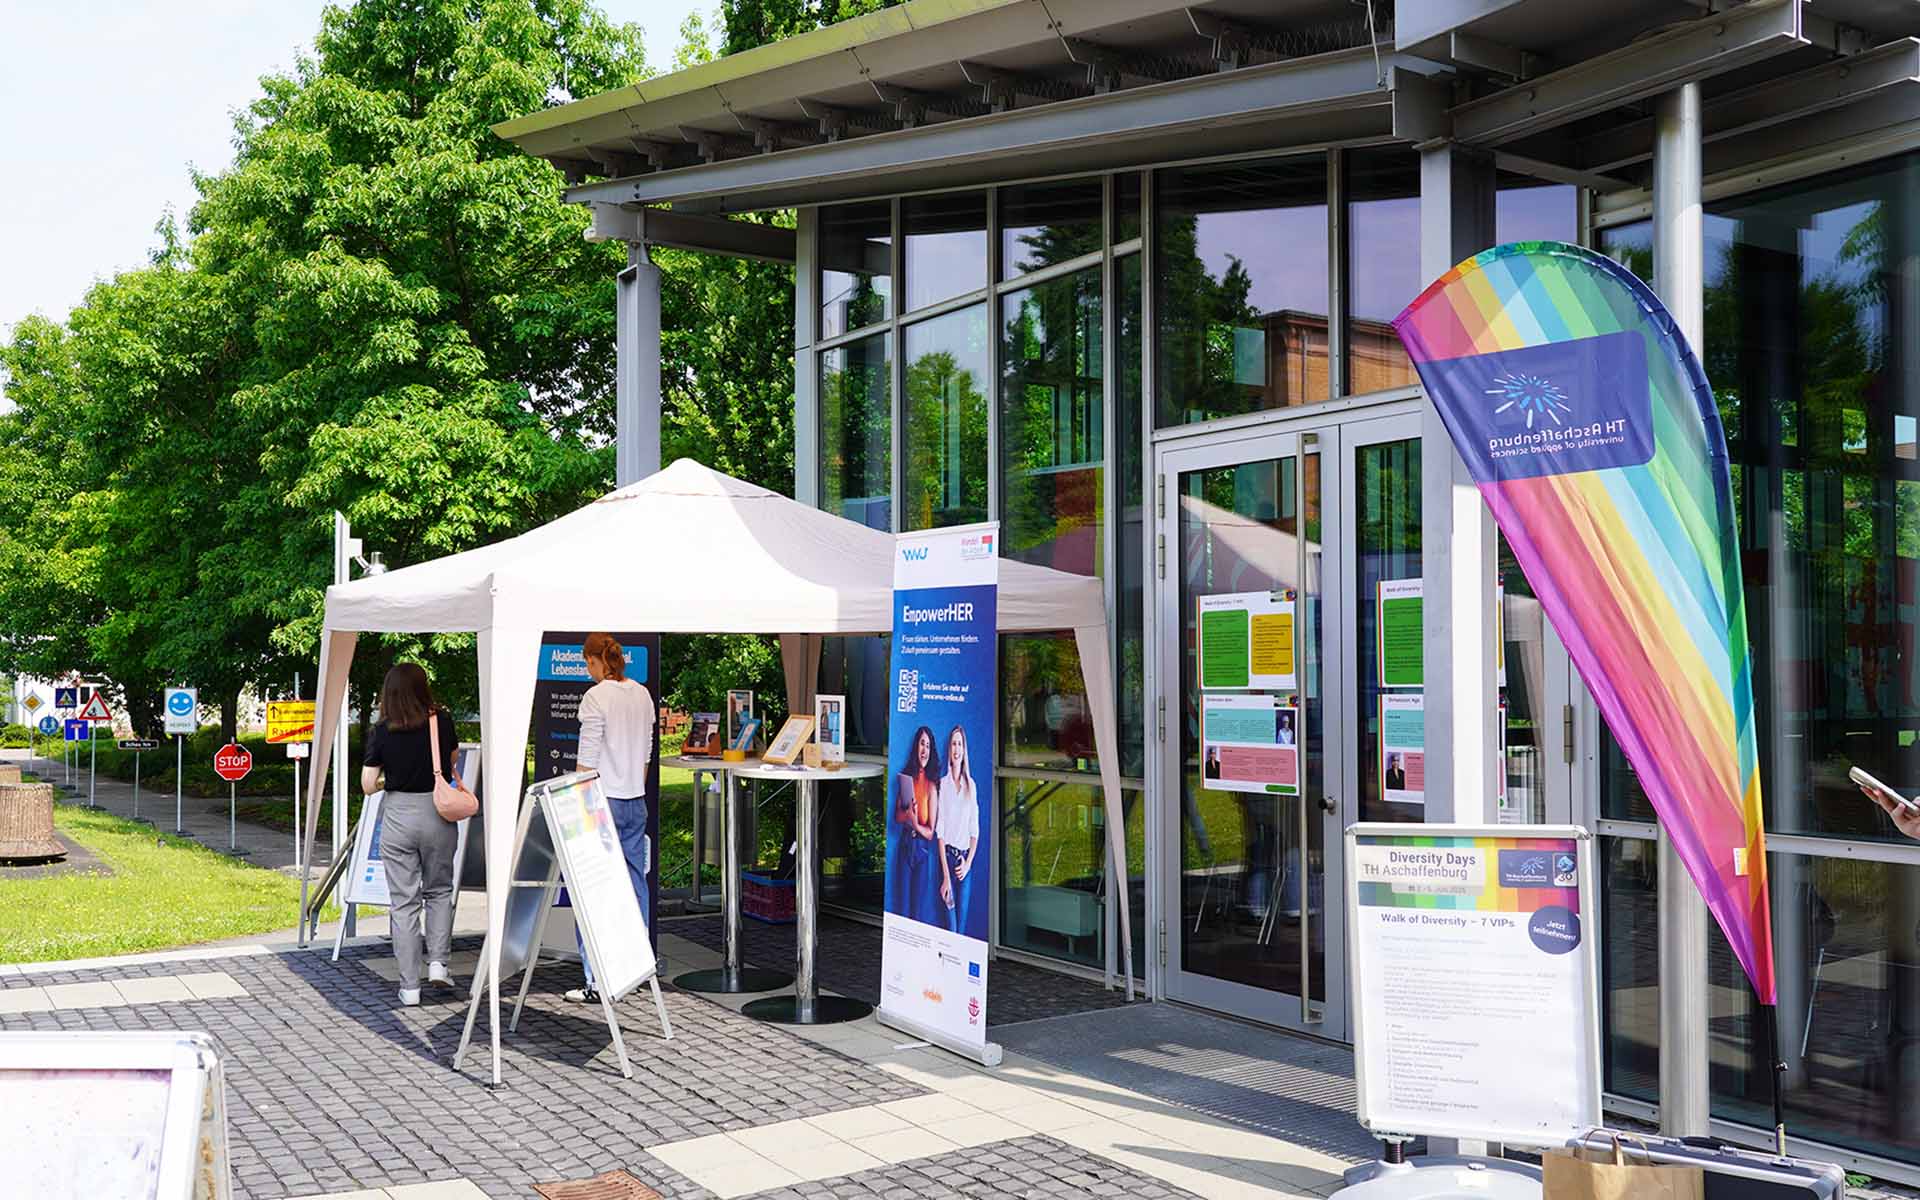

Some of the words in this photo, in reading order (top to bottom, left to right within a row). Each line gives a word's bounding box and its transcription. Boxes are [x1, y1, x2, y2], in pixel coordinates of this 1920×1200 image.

[903, 602, 973, 626] EmpowerHER
[219, 756, 248, 767] STOP
[1390, 851, 1442, 867] Diversity
[1446, 853, 1476, 868] Days
[1363, 863, 1379, 875] TH
[1383, 864, 1468, 881] Aschaffenburg
[1381, 913, 1406, 923] Walk
[1409, 914, 1419, 924] of
[1422, 915, 1467, 928] Diversity
[1481, 918, 1487, 927] 7
[1490, 918, 1515, 928] VIPs
[1546, 920, 1565, 930] Jetzt
[1533, 926, 1577, 941] teilnehmen!
